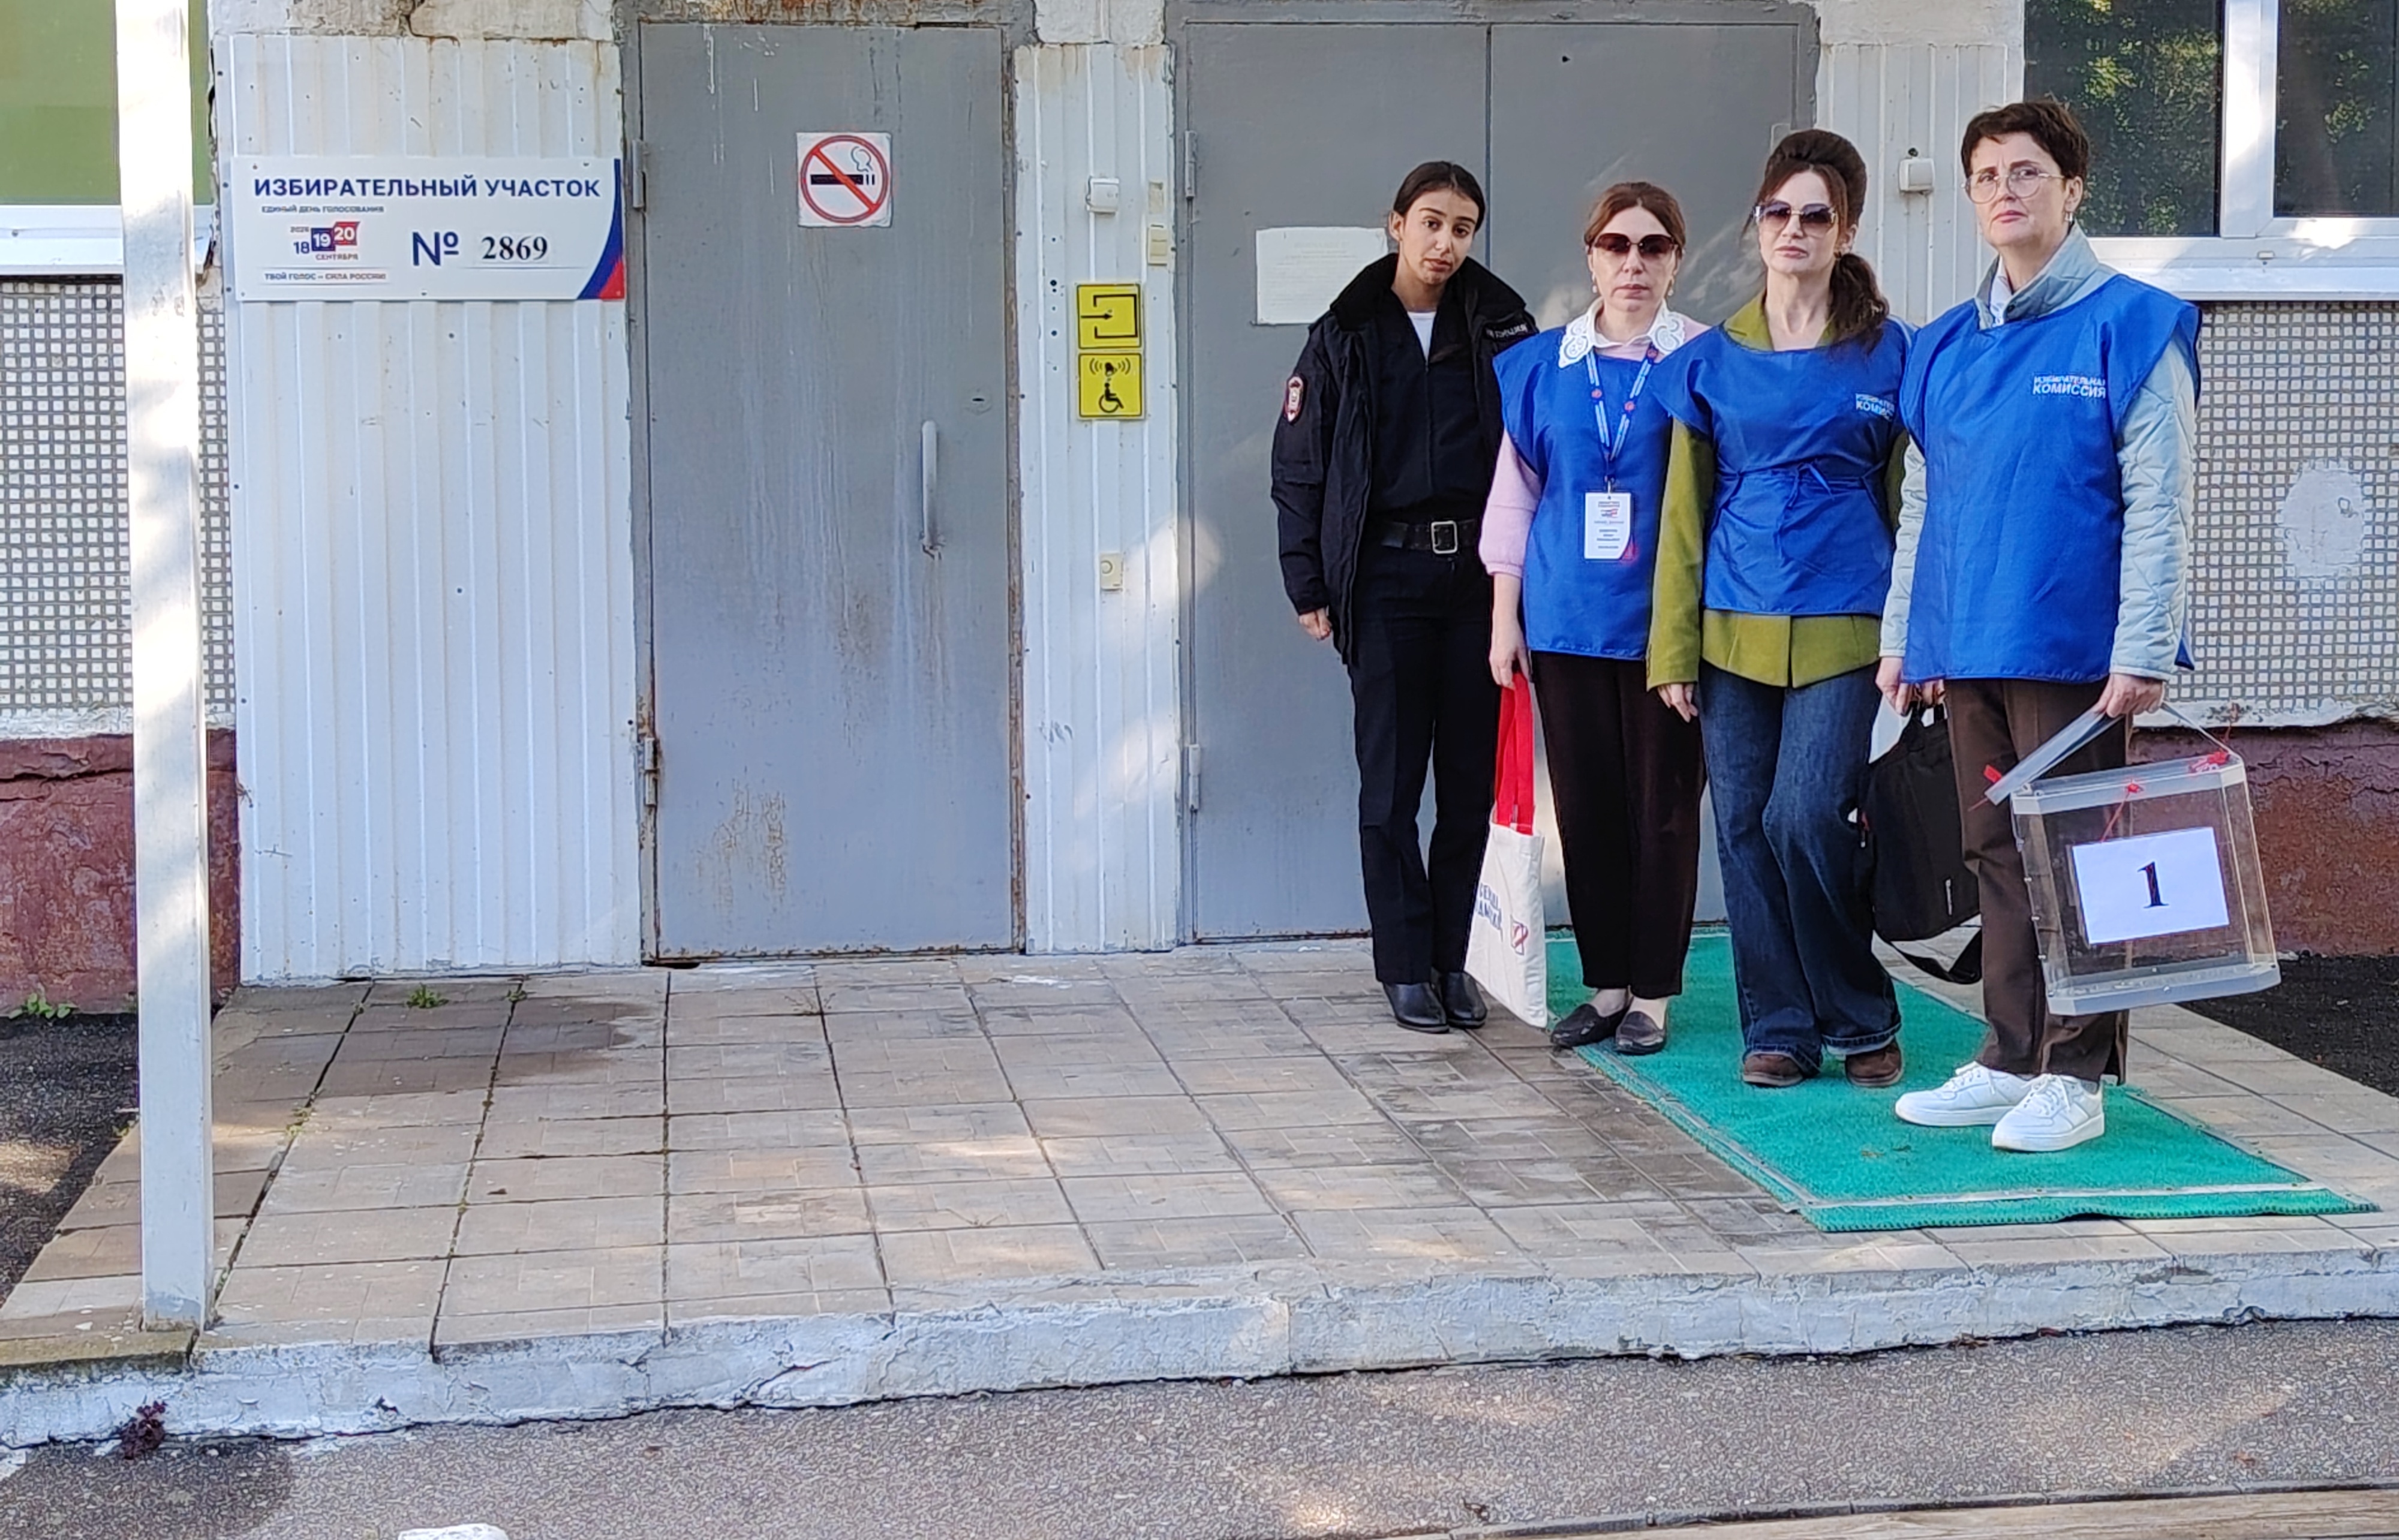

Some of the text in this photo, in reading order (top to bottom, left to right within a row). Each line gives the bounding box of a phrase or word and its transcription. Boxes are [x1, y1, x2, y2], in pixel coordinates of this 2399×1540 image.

[254, 175, 600, 197] ИЗБИРАТЕЛЬНЫЙ УЧАСТОК
[293, 227, 355, 254] 18 19 20
[412, 231, 548, 266] № 2869
[2033, 383, 2106, 398] КОМИССИЯ
[2137, 862, 2169, 909] 1
